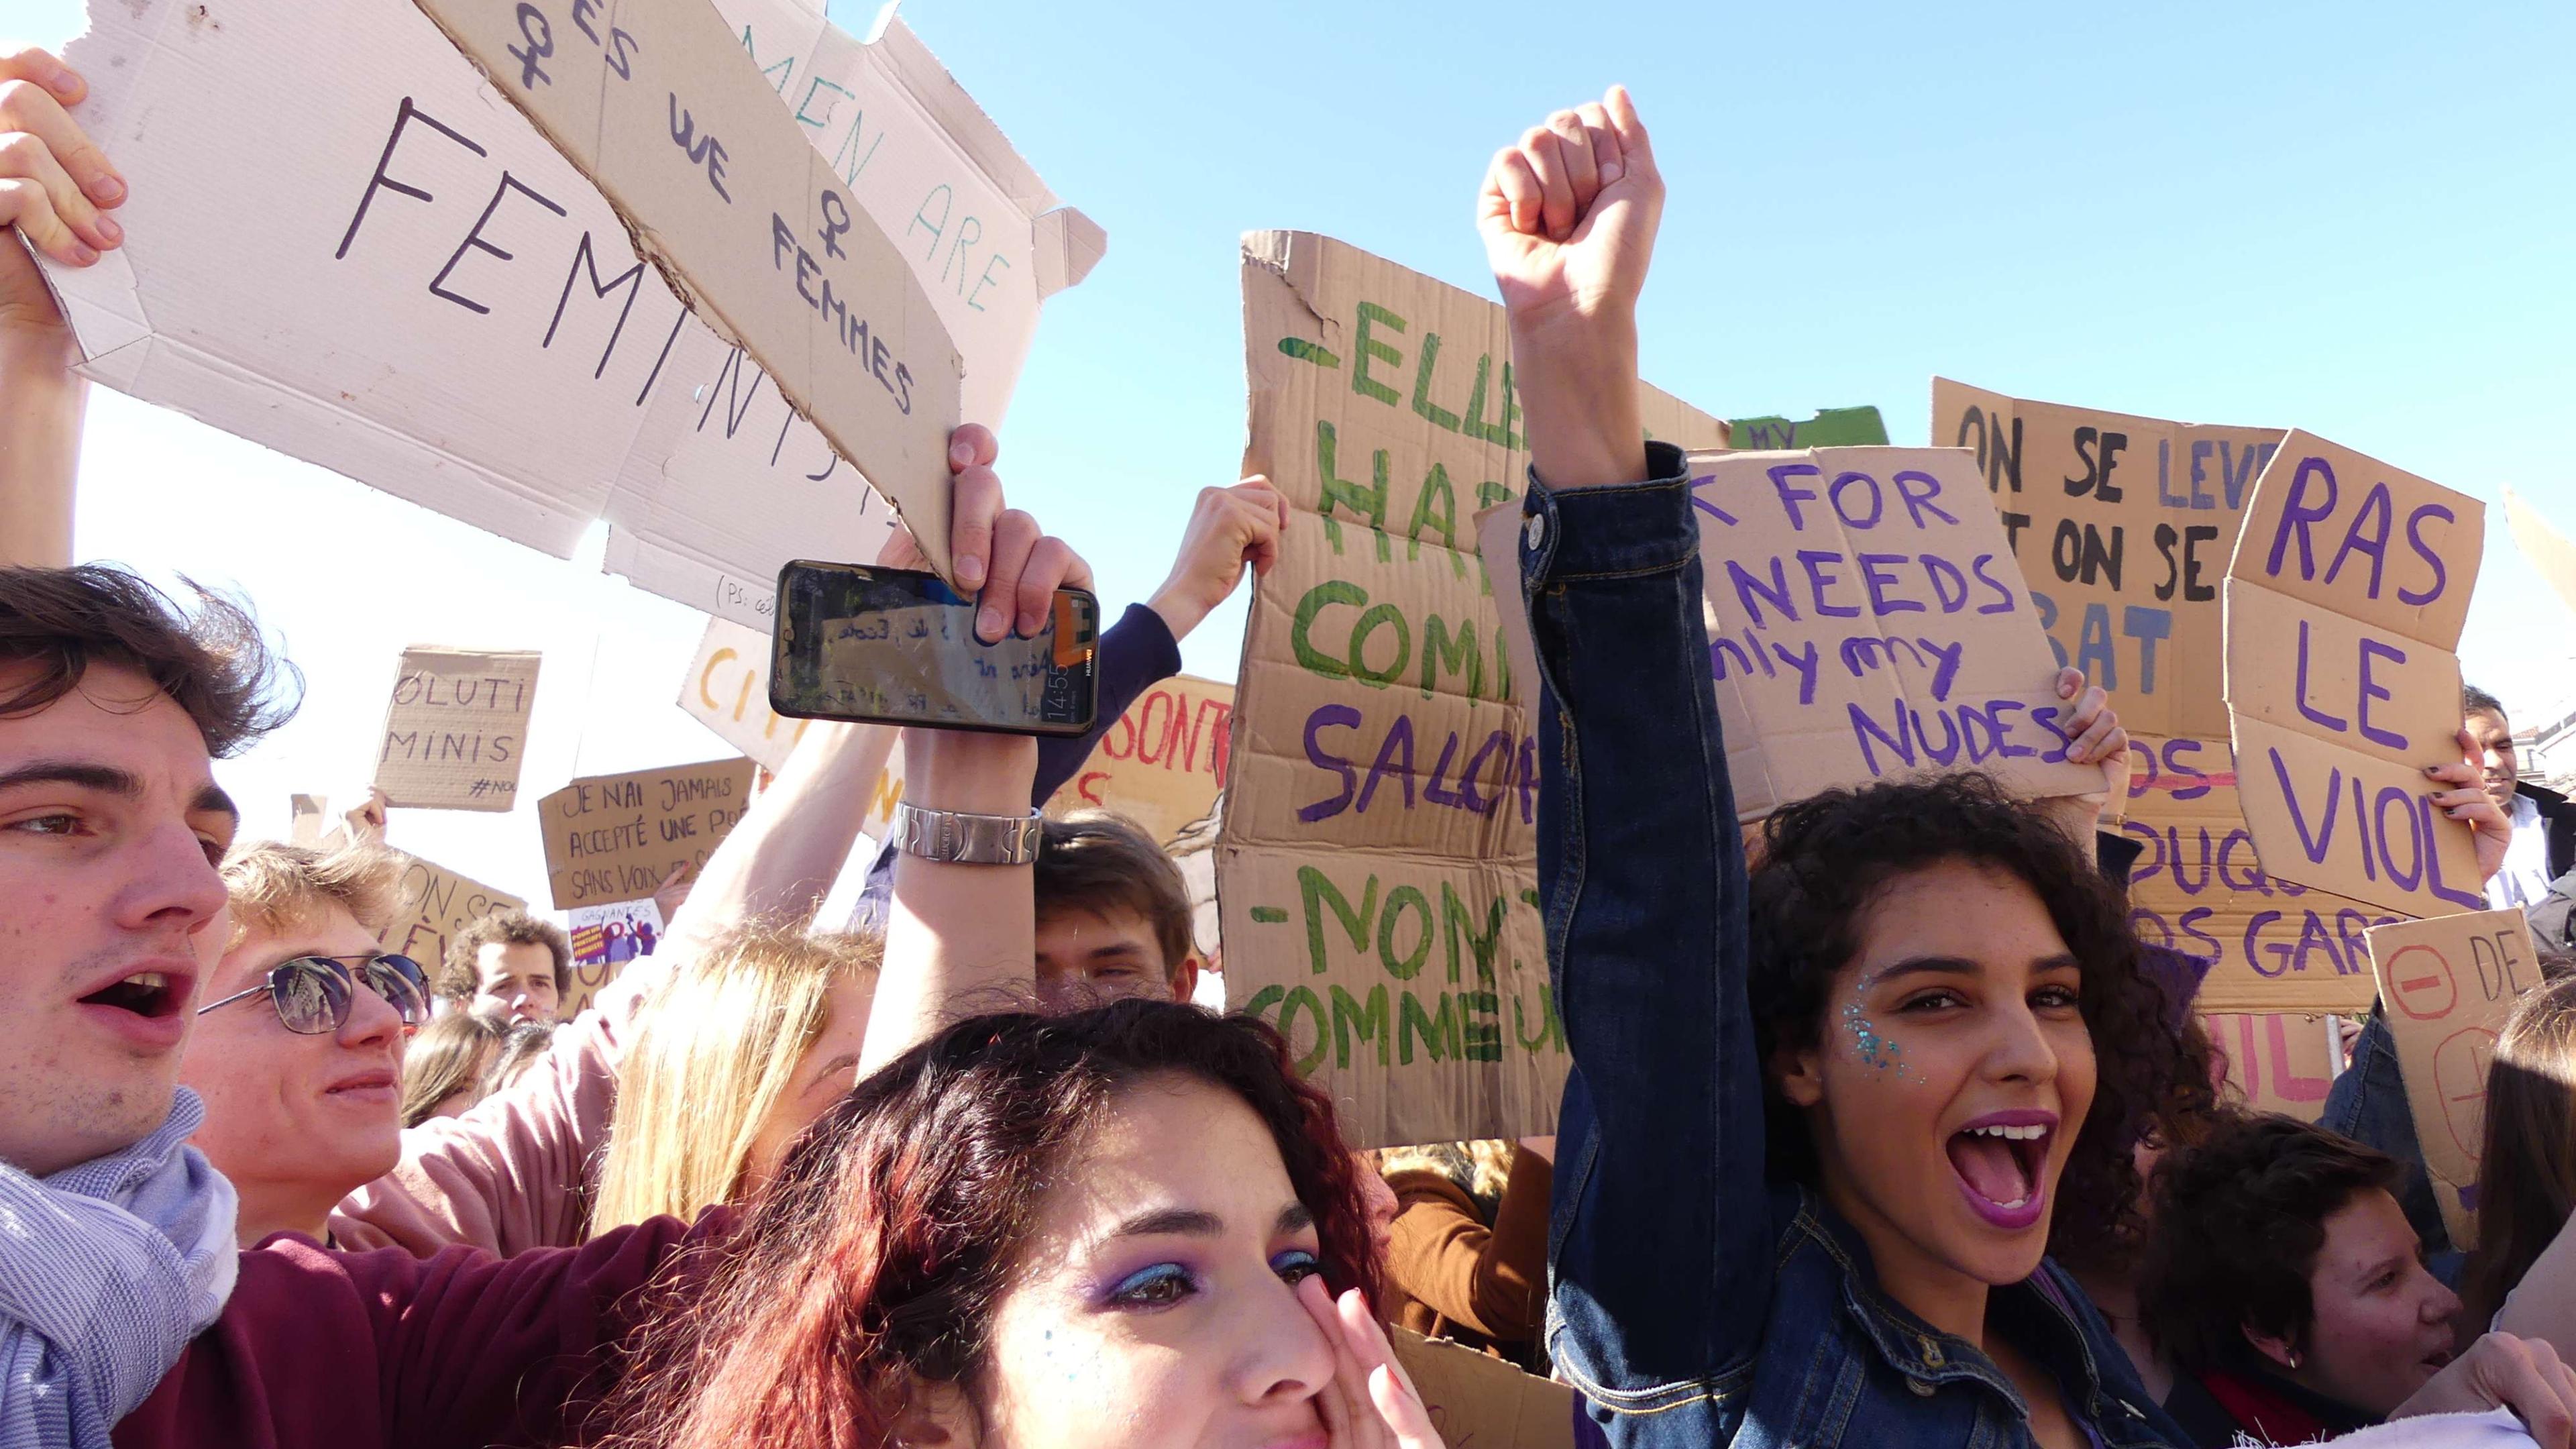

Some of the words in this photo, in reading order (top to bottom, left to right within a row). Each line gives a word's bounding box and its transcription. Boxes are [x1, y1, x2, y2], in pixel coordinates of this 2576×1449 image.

[908, 184, 1010, 312] ARE
[334, 96, 896, 527] FEMINI
[773, 212, 914, 415] FEMMES
[1748, 423, 1796, 449] MY
[2063, 427, 2128, 503] SE
[1767, 464, 1960, 531] FOR
[2265, 457, 2455, 606] RAS
[1725, 549, 2015, 629] NEEDS
[2052, 517, 2124, 592] ON
[2153, 523, 2218, 602] SE
[1046, 663, 1069, 720] 14:55
[1085, 649, 1093, 677] HUAWEI
[1839, 636, 1963, 702] my
[2296, 620, 2408, 750] LE
[1846, 698, 2072, 776] NUDES
[563, 785, 593, 818] JE
[602, 781, 643, 809] N'AI
[660, 777, 732, 812] JAMAIS
[2269, 747, 2481, 910] VIOL
[570, 814, 646, 859] ACCEPTÉ
[659, 814, 697, 842] UNE
[571, 870, 613, 900] SANS
[618, 865, 662, 894] VOIX
[2469, 930, 2534, 1002] DE
